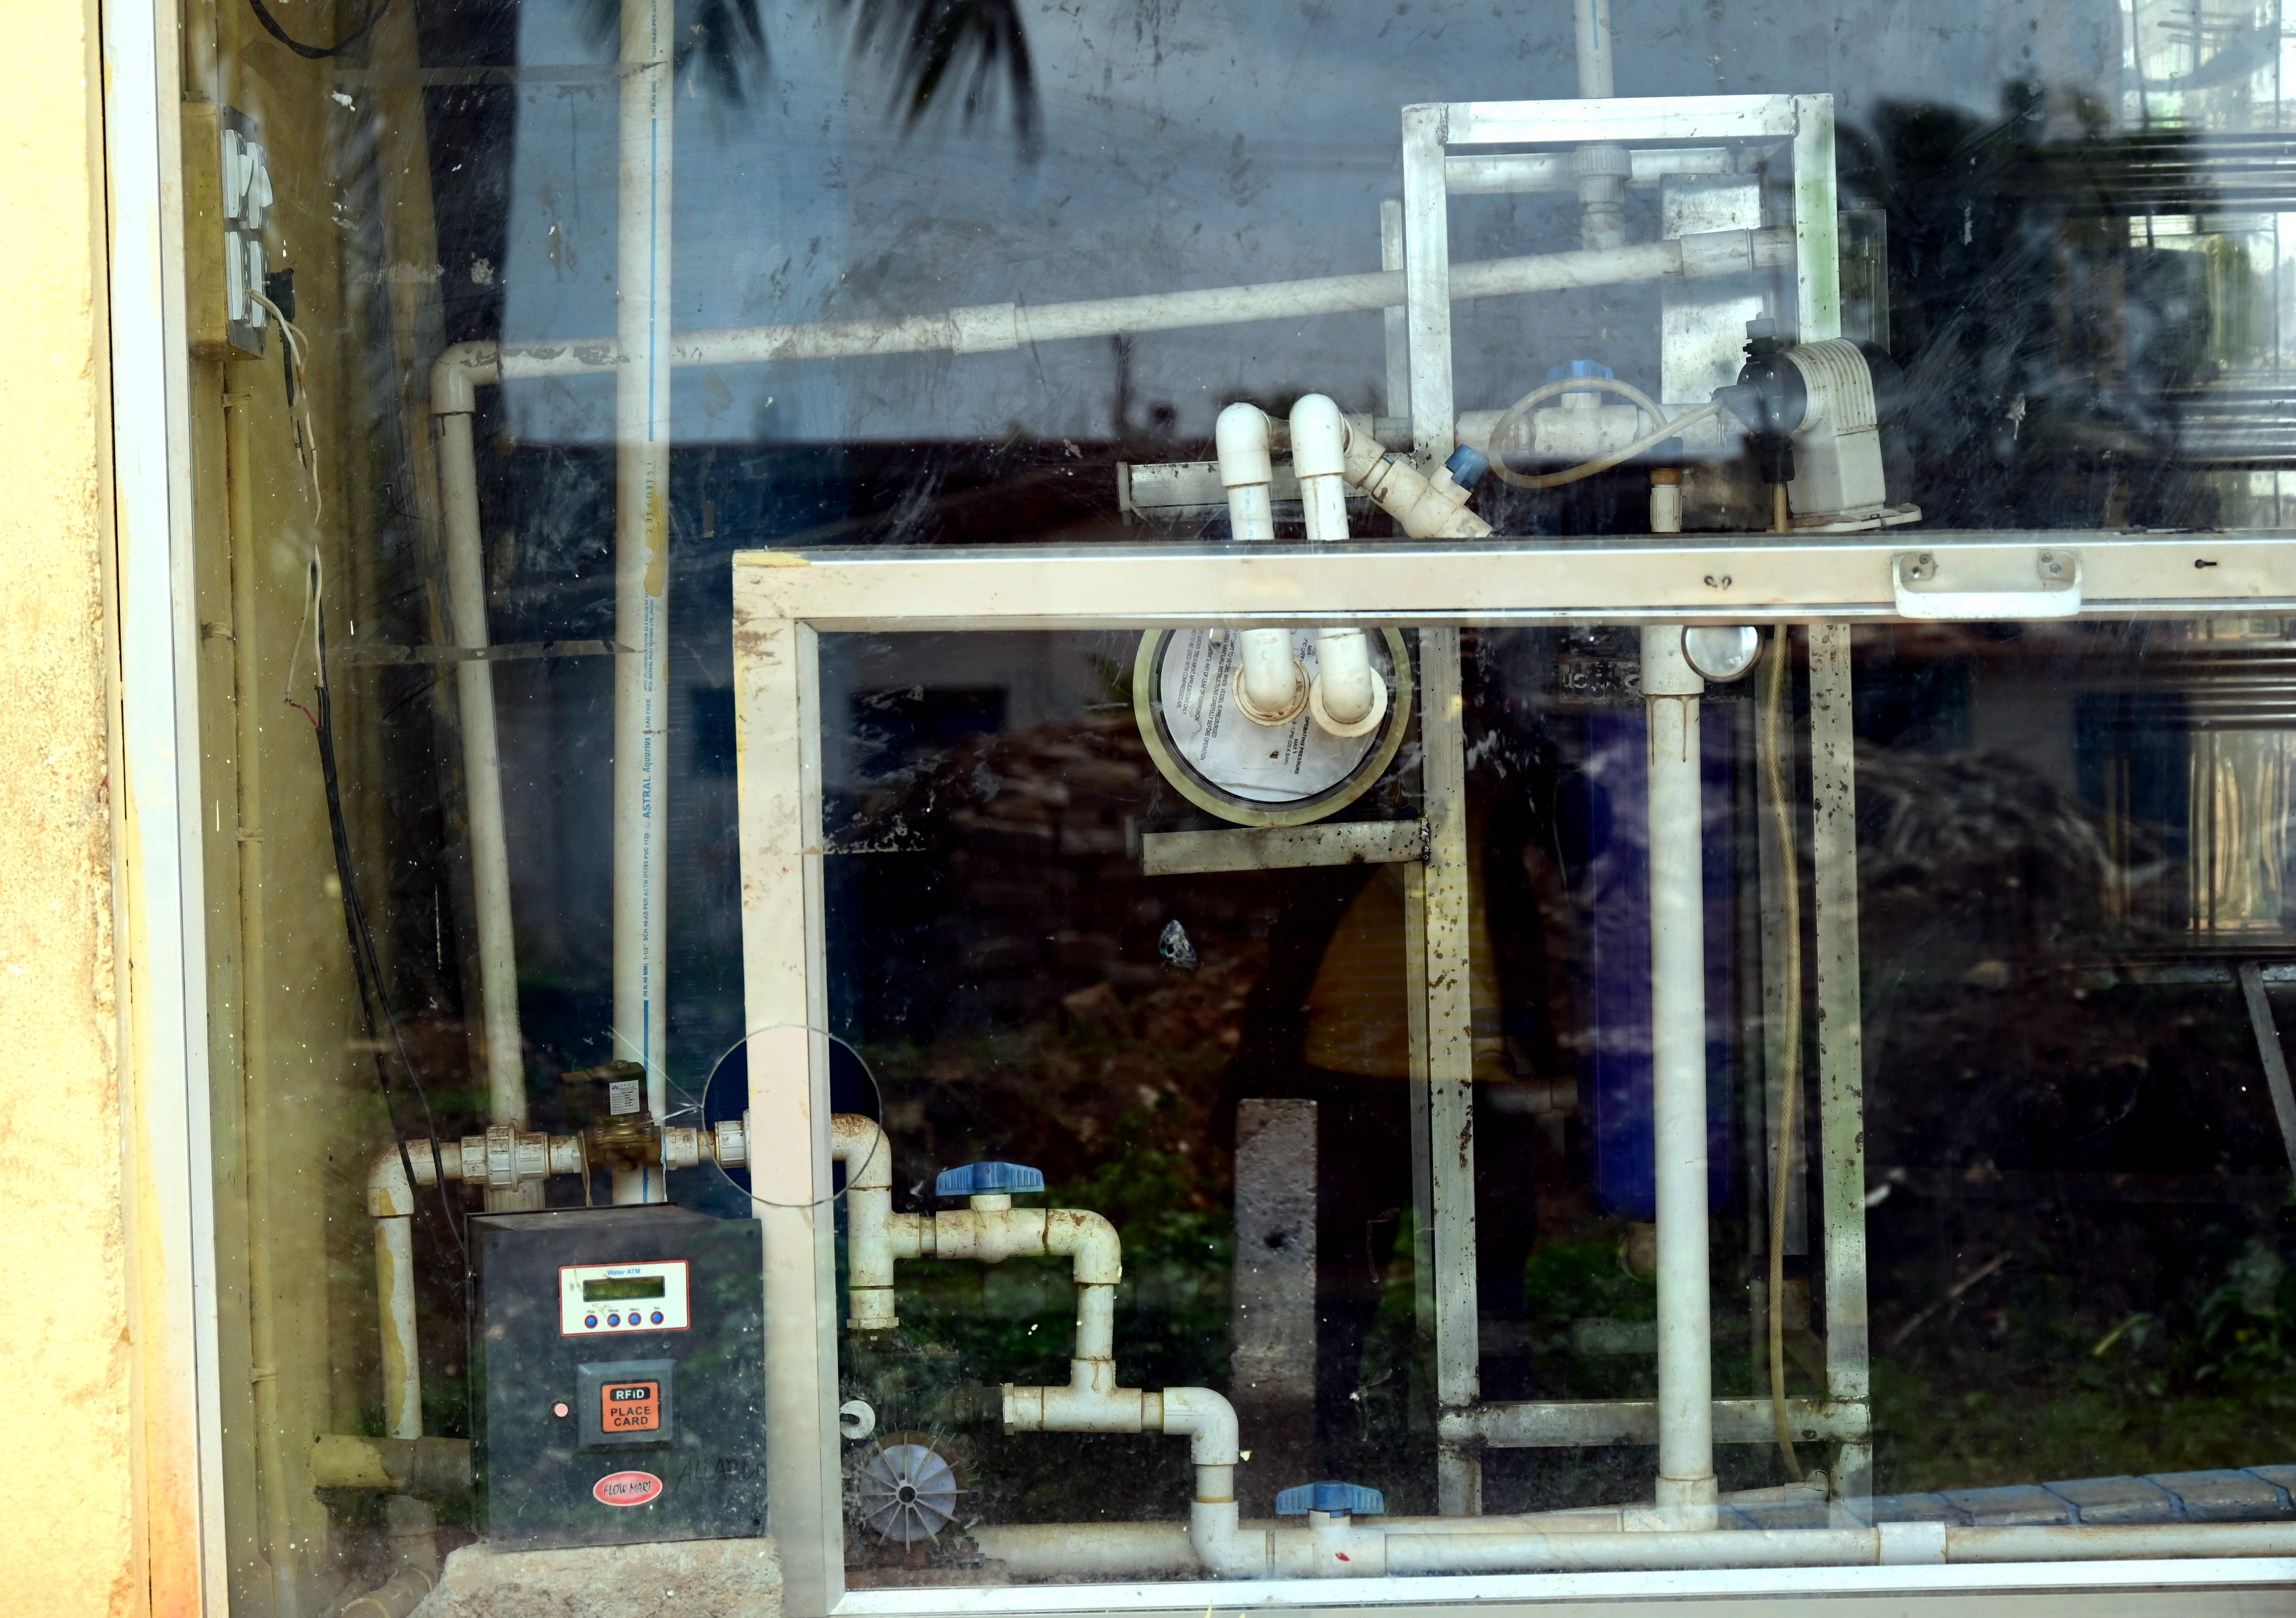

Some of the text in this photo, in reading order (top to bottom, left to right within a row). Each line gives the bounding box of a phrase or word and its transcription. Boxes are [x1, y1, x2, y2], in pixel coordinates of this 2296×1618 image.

[1190, 650, 1200, 674] TREATMENT
[1224, 657, 1232, 674] VESSEL
[1177, 671, 1188, 700] COMPRESSED
[1184, 674, 1194, 703] APPLICATIONS
[1212, 665, 1223, 696] INSTRUCTIONS
[1218, 687, 1226, 704] VESSEL
[1208, 696, 1217, 720] CAREFULLY
[1204, 719, 1213, 737] BEFORE
[1211, 709, 1222, 738] PRESSURISED
[642, 737, 652, 773] Aquarius
[1200, 736, 1209, 761] OPERATION
[1294, 716, 1310, 775] OPERATING PRESSURE
[642, 776, 651, 819] ASTRAL
[643, 911, 648, 920] AS
[611, 1406, 651, 1416] PLACE
[614, 1416, 648, 1426] CARD
[603, 1481, 652, 1496] FLOW MART
